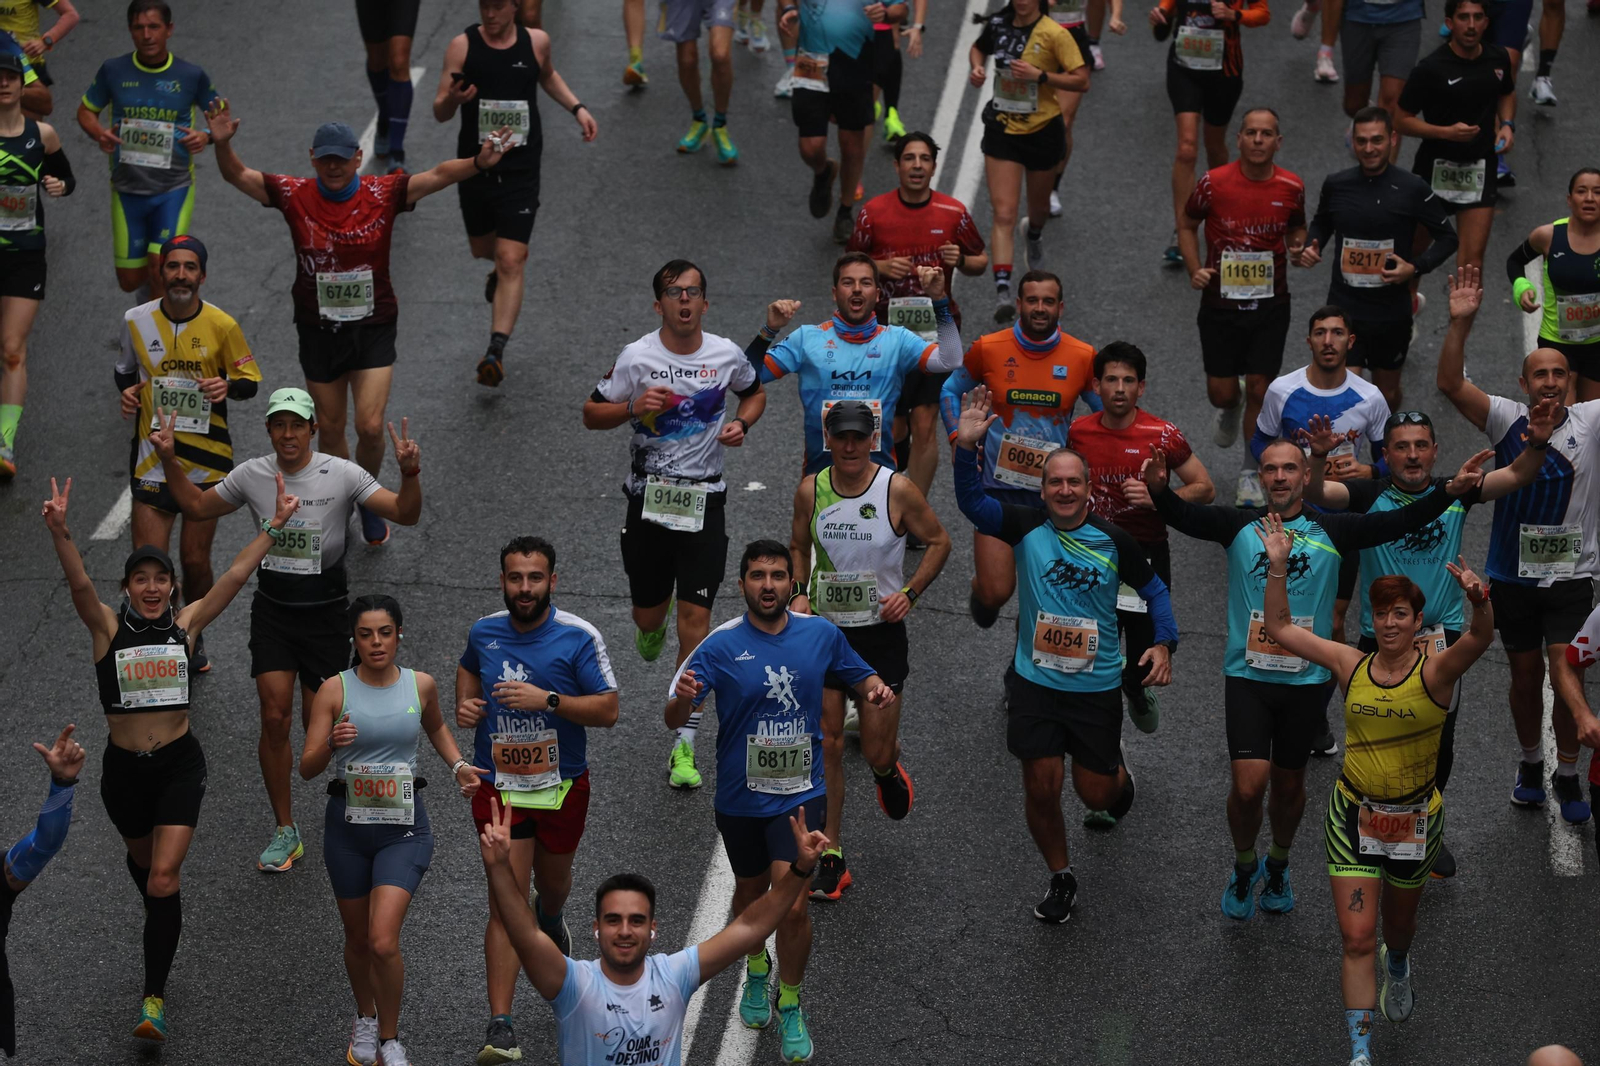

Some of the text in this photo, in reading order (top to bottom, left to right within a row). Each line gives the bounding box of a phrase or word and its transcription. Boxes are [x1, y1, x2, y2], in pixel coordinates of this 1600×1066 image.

[123, 107, 178, 121] TUSSAM
[483, 111, 521, 126] 10288
[1441, 170, 1473, 184] 9436
[0, 196, 26, 212] 405
[1349, 251, 1382, 267] 5217
[1226, 264, 1266, 278] 11619
[326, 284, 361, 299] 6742
[897, 309, 931, 324] 9789
[1566, 304, 1600, 321] 8030
[161, 359, 202, 372] CORRE
[650, 364, 717, 384] calderón
[161, 391, 197, 408] 6876
[1011, 391, 1056, 402] Genacol
[1008, 447, 1044, 469] 6092
[654, 489, 691, 507] 9148
[823, 522, 857, 531] ATLÉTIC
[272, 532, 307, 549] 955
[822, 531, 872, 541] RANIN CLUB
[1529, 538, 1568, 554] 6752
[1402, 557, 1420, 565] TRES
[826, 585, 863, 603] 9879
[1286, 588, 1305, 596] REN
[1043, 628, 1083, 648] 4054
[124, 659, 178, 681] 10068
[1350, 703, 1416, 719] OSUNA
[497, 715, 546, 734] Alcalá
[756, 716, 806, 736] Alcalá
[501, 746, 543, 765] 5092
[757, 749, 799, 768] 6817
[354, 778, 397, 798] 9300
[1368, 815, 1411, 834] 4004
[653, 1039, 660, 1047] es
[615, 1047, 660, 1065] DESTINO
